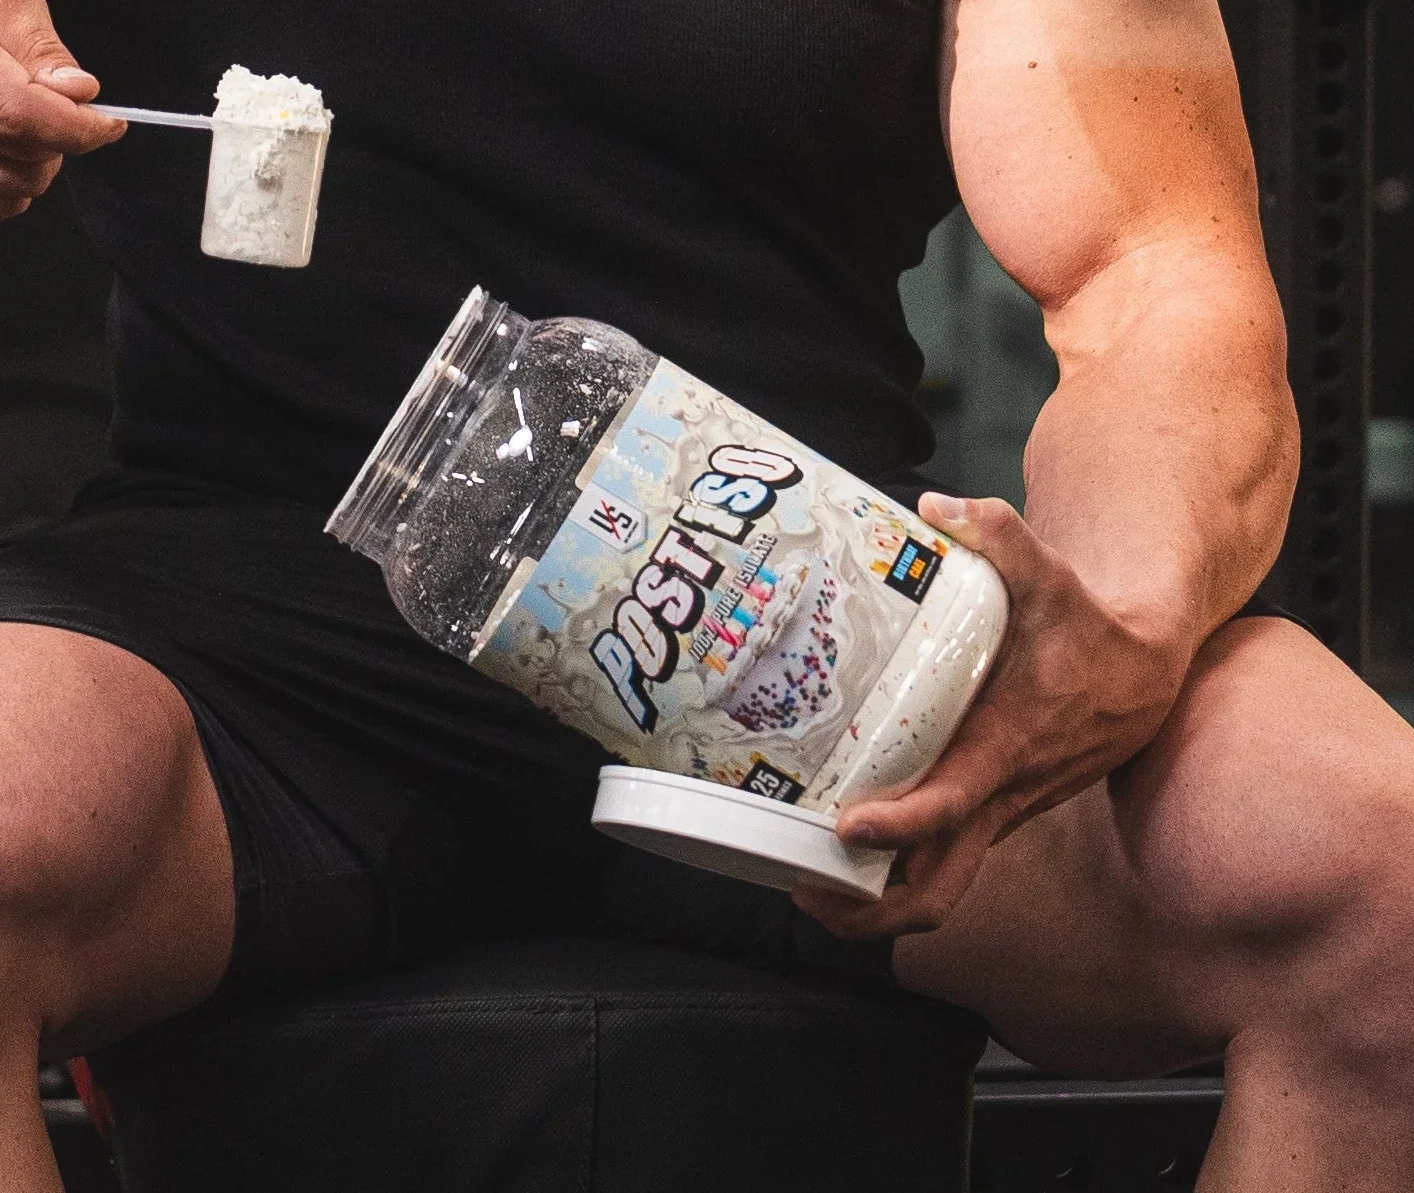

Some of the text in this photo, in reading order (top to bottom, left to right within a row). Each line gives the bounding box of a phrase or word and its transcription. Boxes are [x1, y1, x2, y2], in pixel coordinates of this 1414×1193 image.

[589, 444, 804, 735] POST ISO
[711, 587, 743, 627] PURE
[734, 533, 777, 589] ISOLATE
[750, 769, 780, 796] 25
